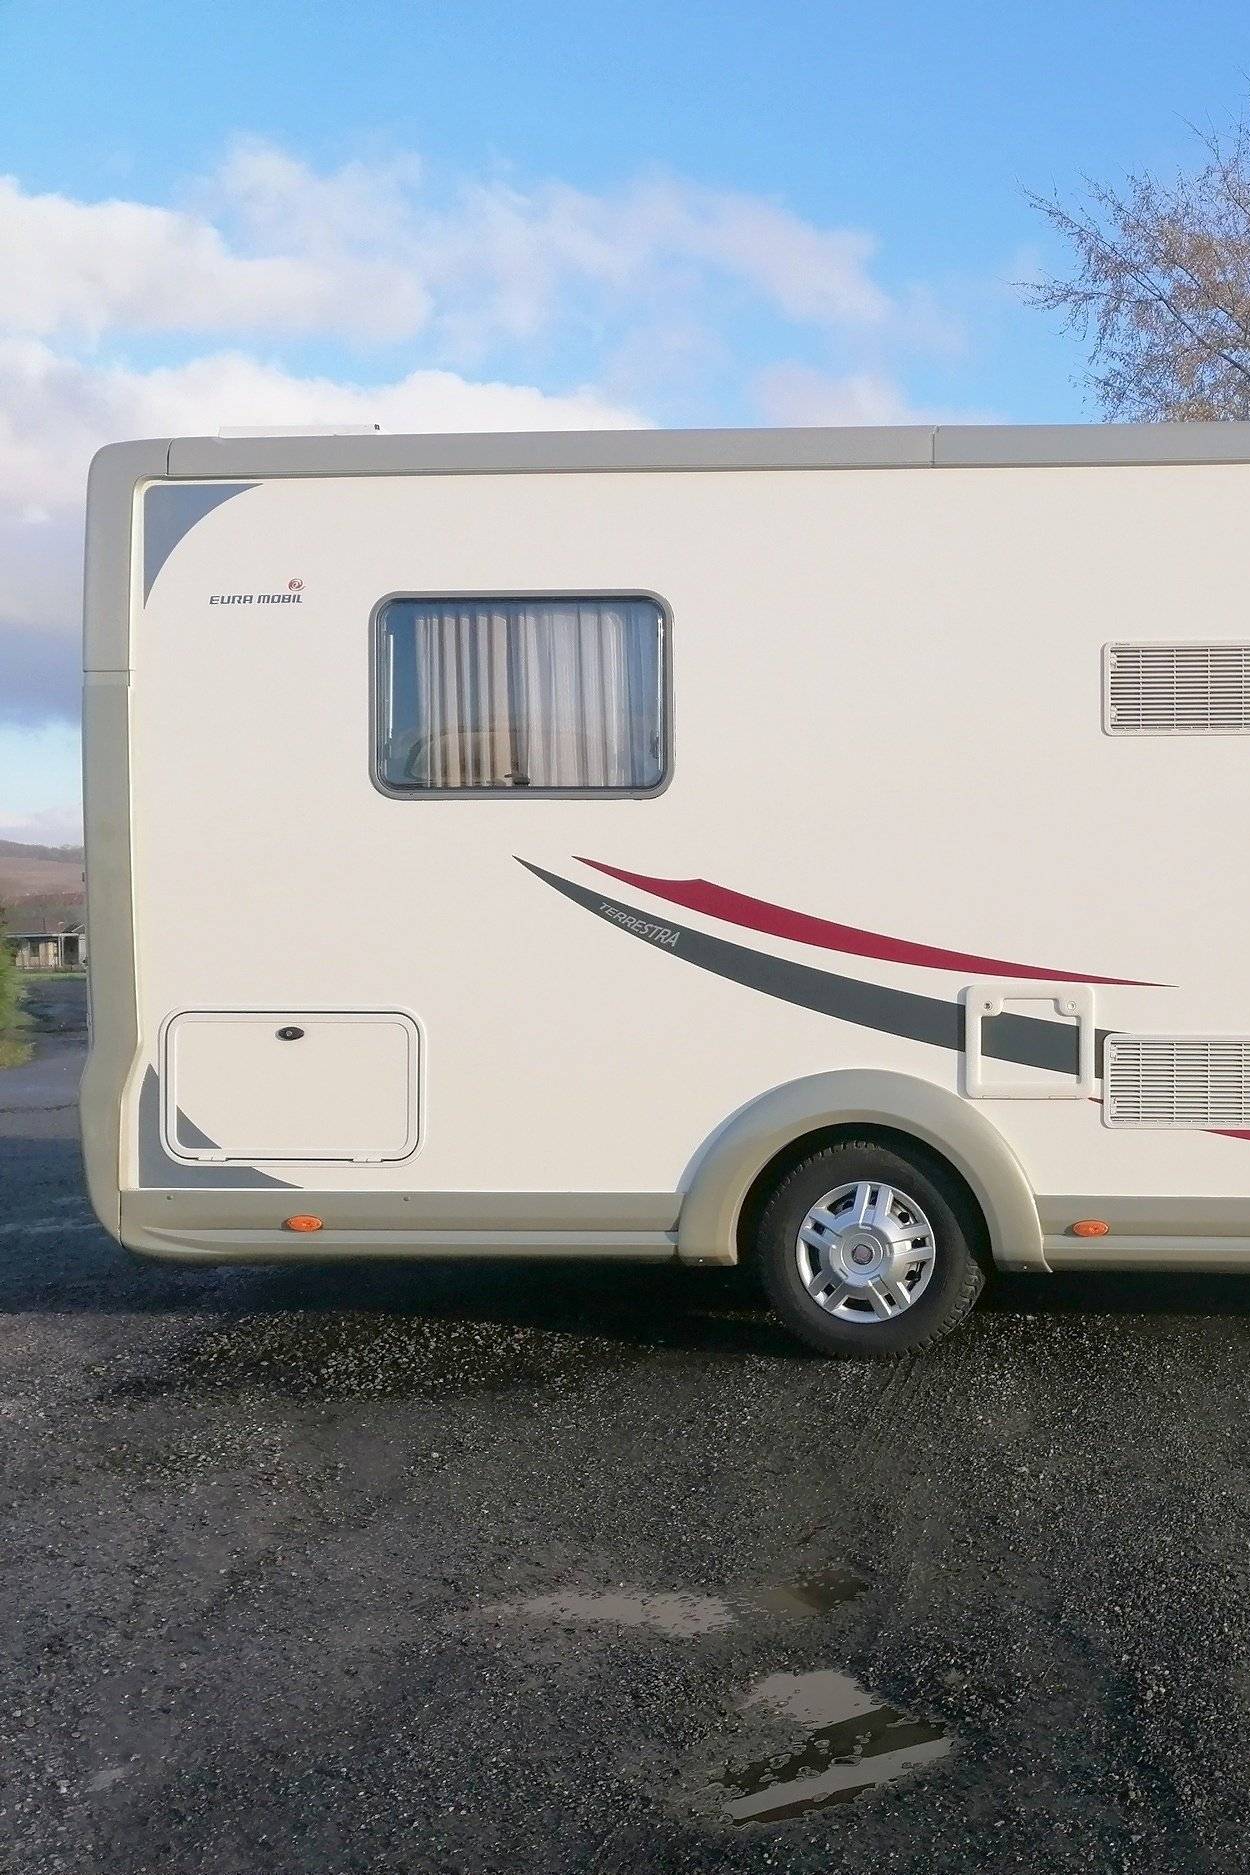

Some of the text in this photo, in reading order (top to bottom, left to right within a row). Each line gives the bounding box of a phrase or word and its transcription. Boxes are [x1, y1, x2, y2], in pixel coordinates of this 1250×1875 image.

[209, 593, 303, 605] EURA MOBIL
[599, 902, 681, 947] TERRESTRA
